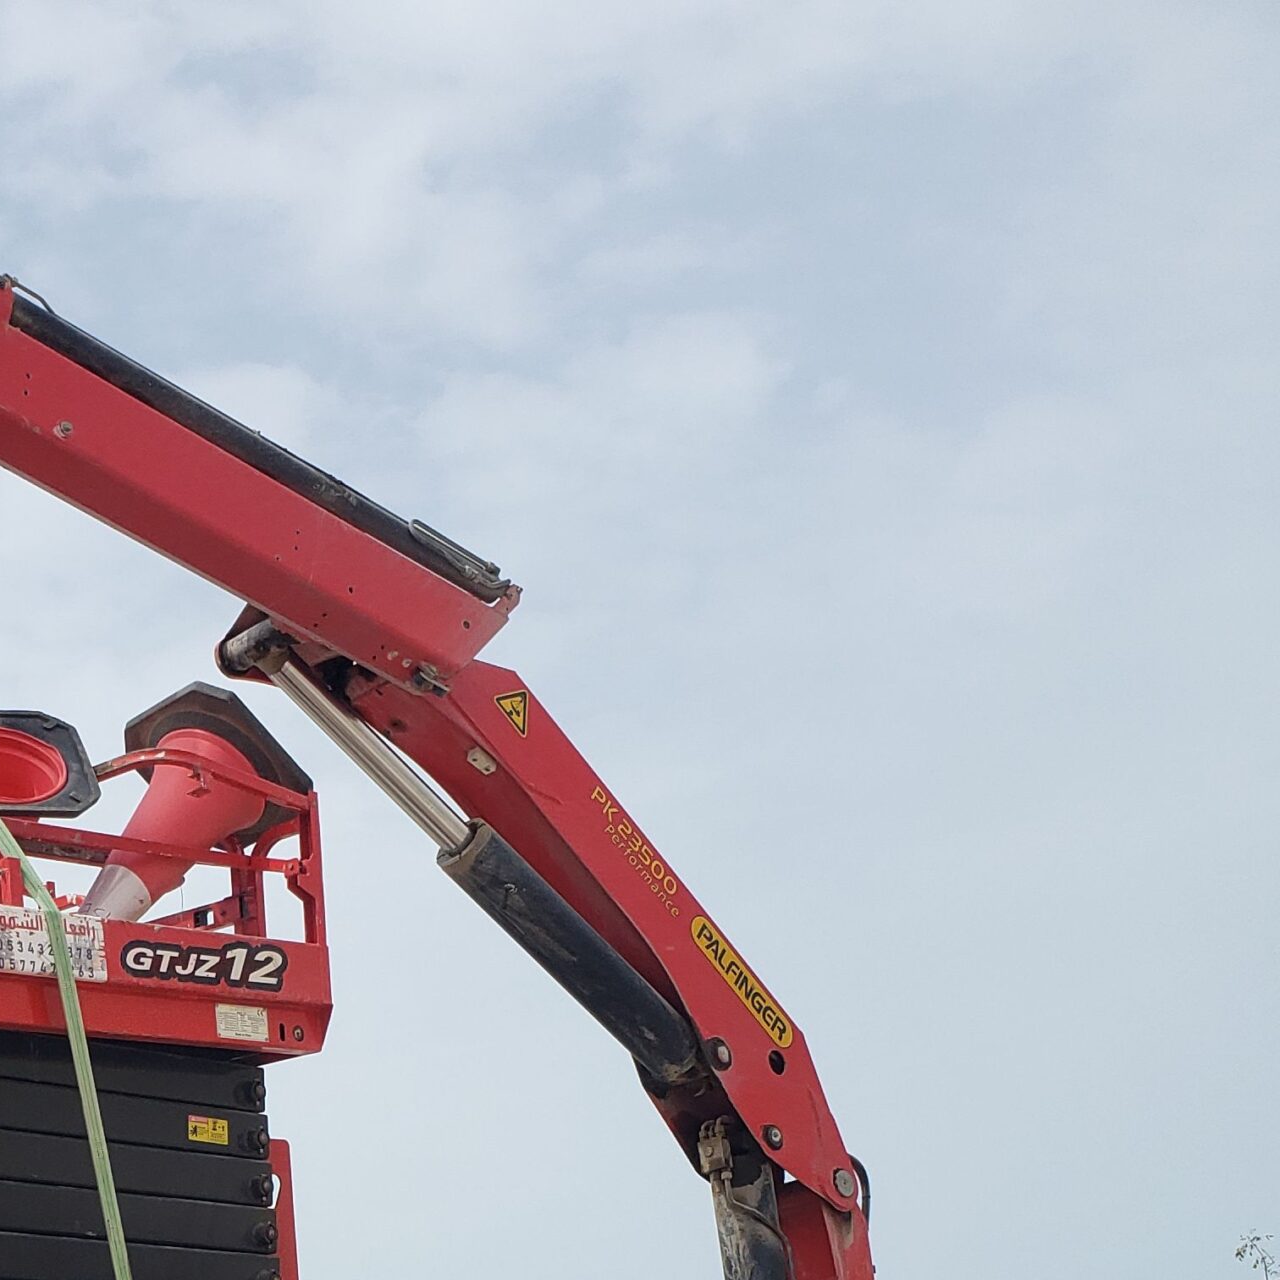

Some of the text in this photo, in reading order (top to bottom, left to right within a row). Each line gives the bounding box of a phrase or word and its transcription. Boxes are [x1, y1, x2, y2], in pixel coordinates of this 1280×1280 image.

[590, 785, 677, 895] PK 23500
[604, 824, 680, 918] Performance
[63, 917, 96, 942] رافعا
[696, 922, 787, 1041] PALFINGER
